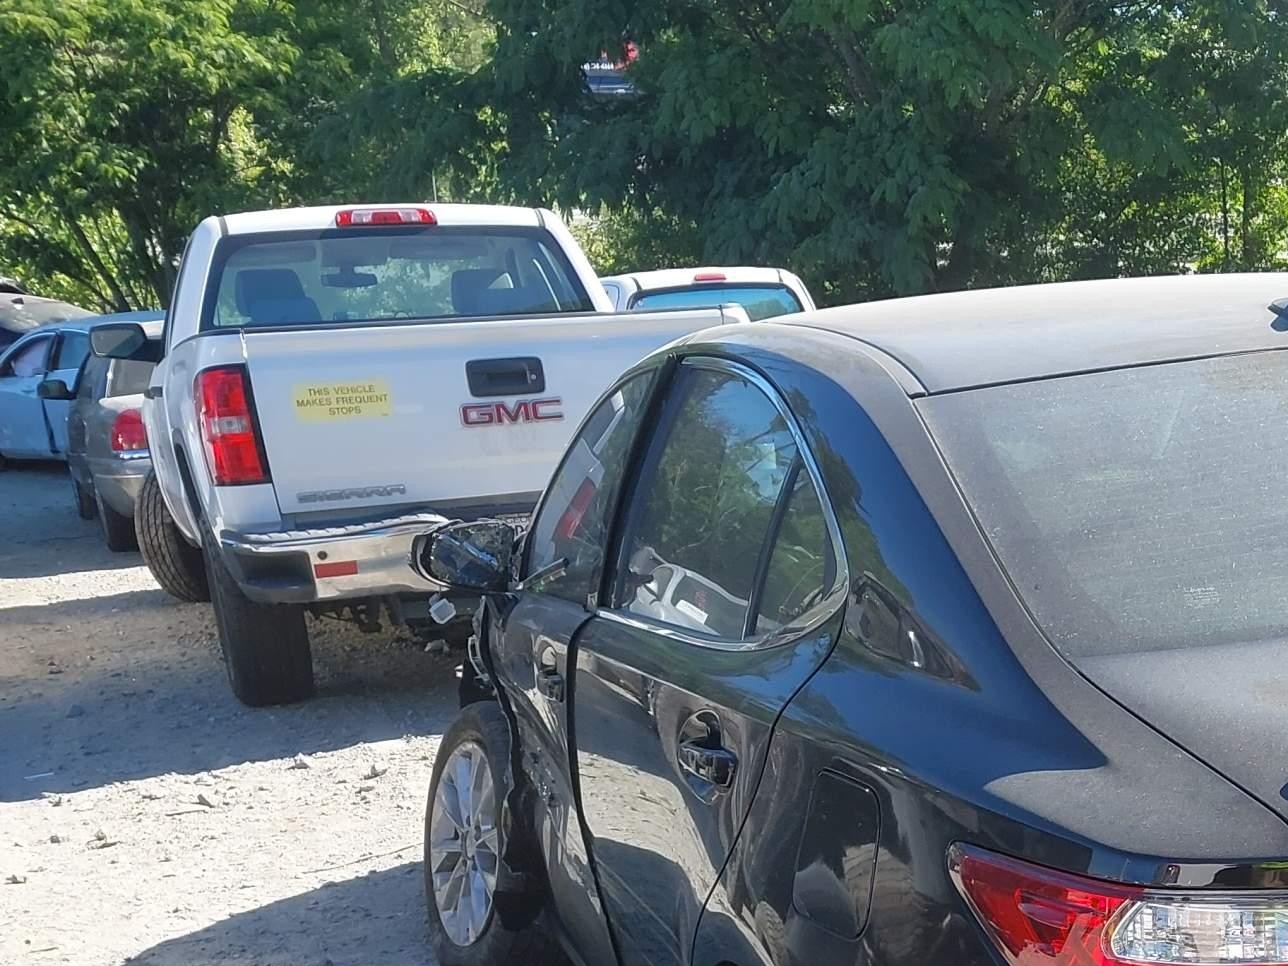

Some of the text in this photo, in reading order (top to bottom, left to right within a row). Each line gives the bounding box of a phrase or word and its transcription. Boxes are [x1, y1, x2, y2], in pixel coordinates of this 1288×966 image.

[308, 384, 376, 397] THIS VEHICLE
[296, 393, 388, 408] MAKES FREQUENT
[328, 405, 362, 416] STOPS
[459, 396, 565, 428] GMC
[295, 483, 407, 504] SIERRA
